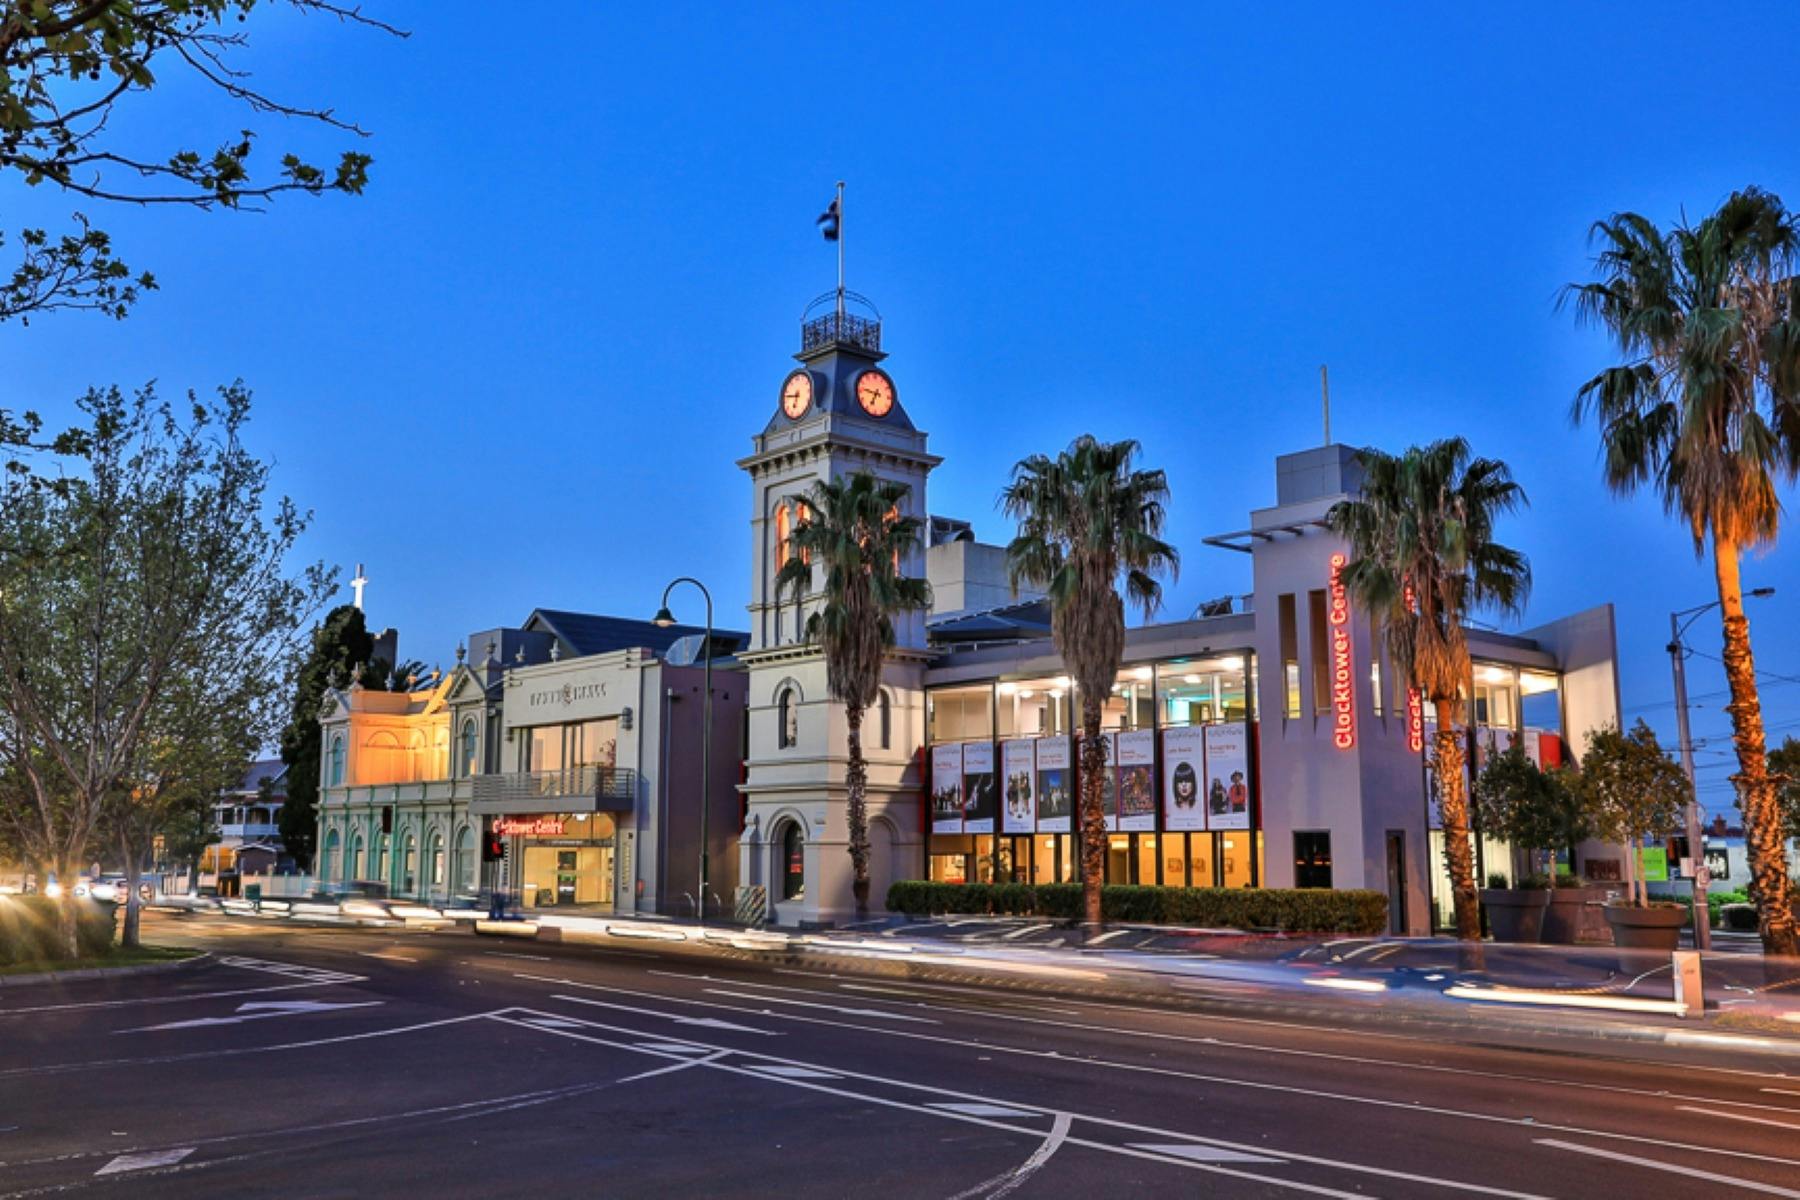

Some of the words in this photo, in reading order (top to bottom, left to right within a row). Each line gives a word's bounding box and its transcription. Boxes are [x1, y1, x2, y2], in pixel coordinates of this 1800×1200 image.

[1329, 554, 1347, 625] Centre
[1334, 628, 1353, 748] Clocktower
[493, 819, 535, 834] Cocktower
